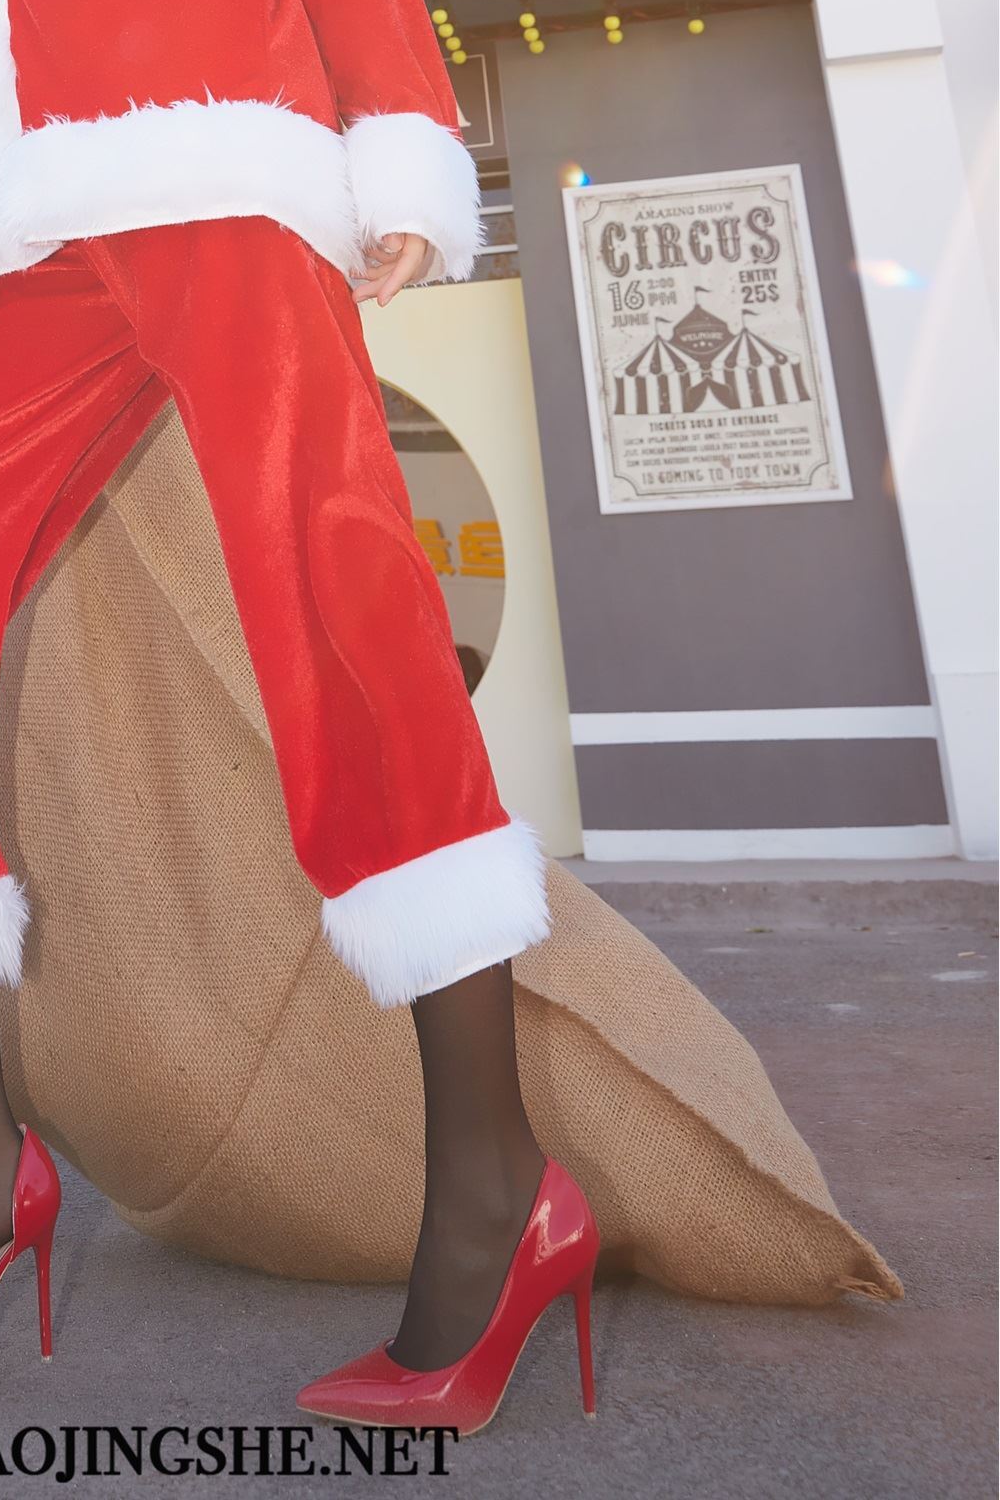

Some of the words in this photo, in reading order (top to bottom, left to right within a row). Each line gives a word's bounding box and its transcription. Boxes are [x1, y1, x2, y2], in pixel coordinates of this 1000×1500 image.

[635, 205, 695, 221] AMAZING
[697, 202, 734, 215] SHOW
[601, 206, 781, 278] CIRCUS
[739, 268, 778, 283] ENTRY
[608, 280, 645, 312] 16
[741, 283, 780, 304] 25$
[612, 313, 649, 328] JUNE
